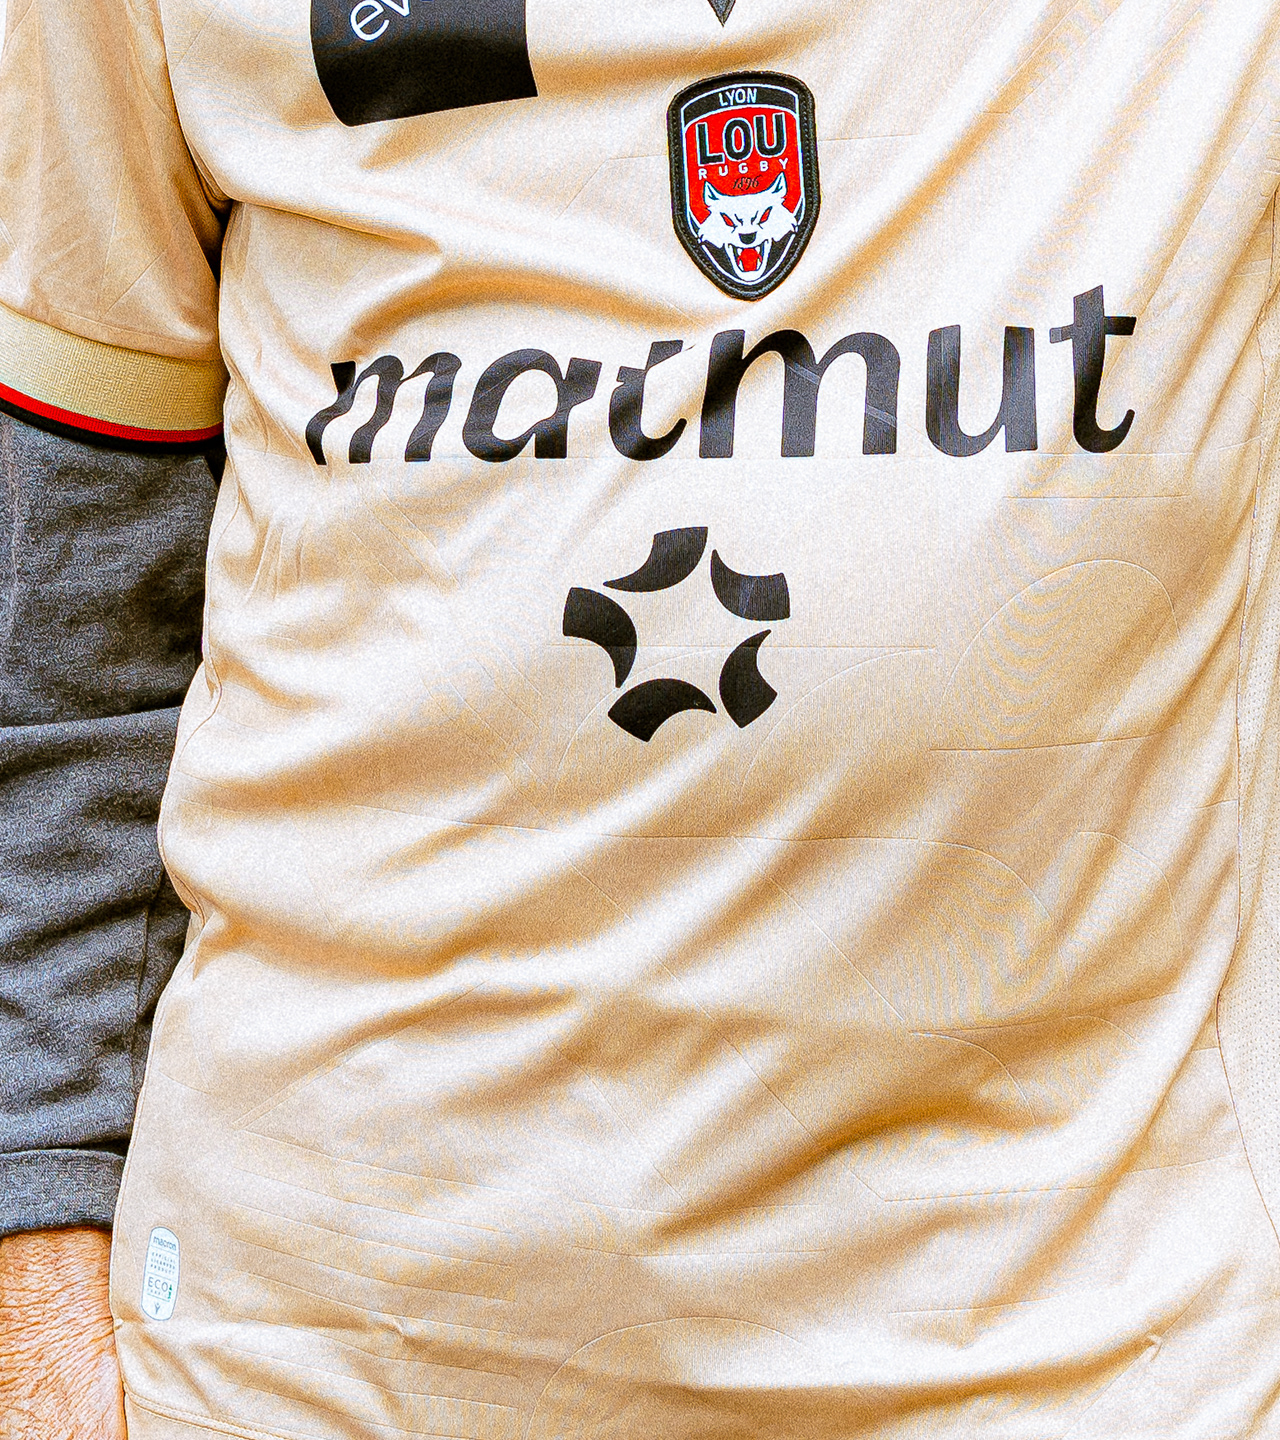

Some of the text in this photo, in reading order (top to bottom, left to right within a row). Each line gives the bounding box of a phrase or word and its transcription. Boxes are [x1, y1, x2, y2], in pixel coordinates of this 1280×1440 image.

[719, 88, 757, 107] LYON
[695, 112, 787, 167] LOU
[698, 157, 789, 180] RUGBY
[304, 284, 1137, 467] matmut
[153, 1236, 177, 1251] macron
[147, 1276, 168, 1292] ECO
